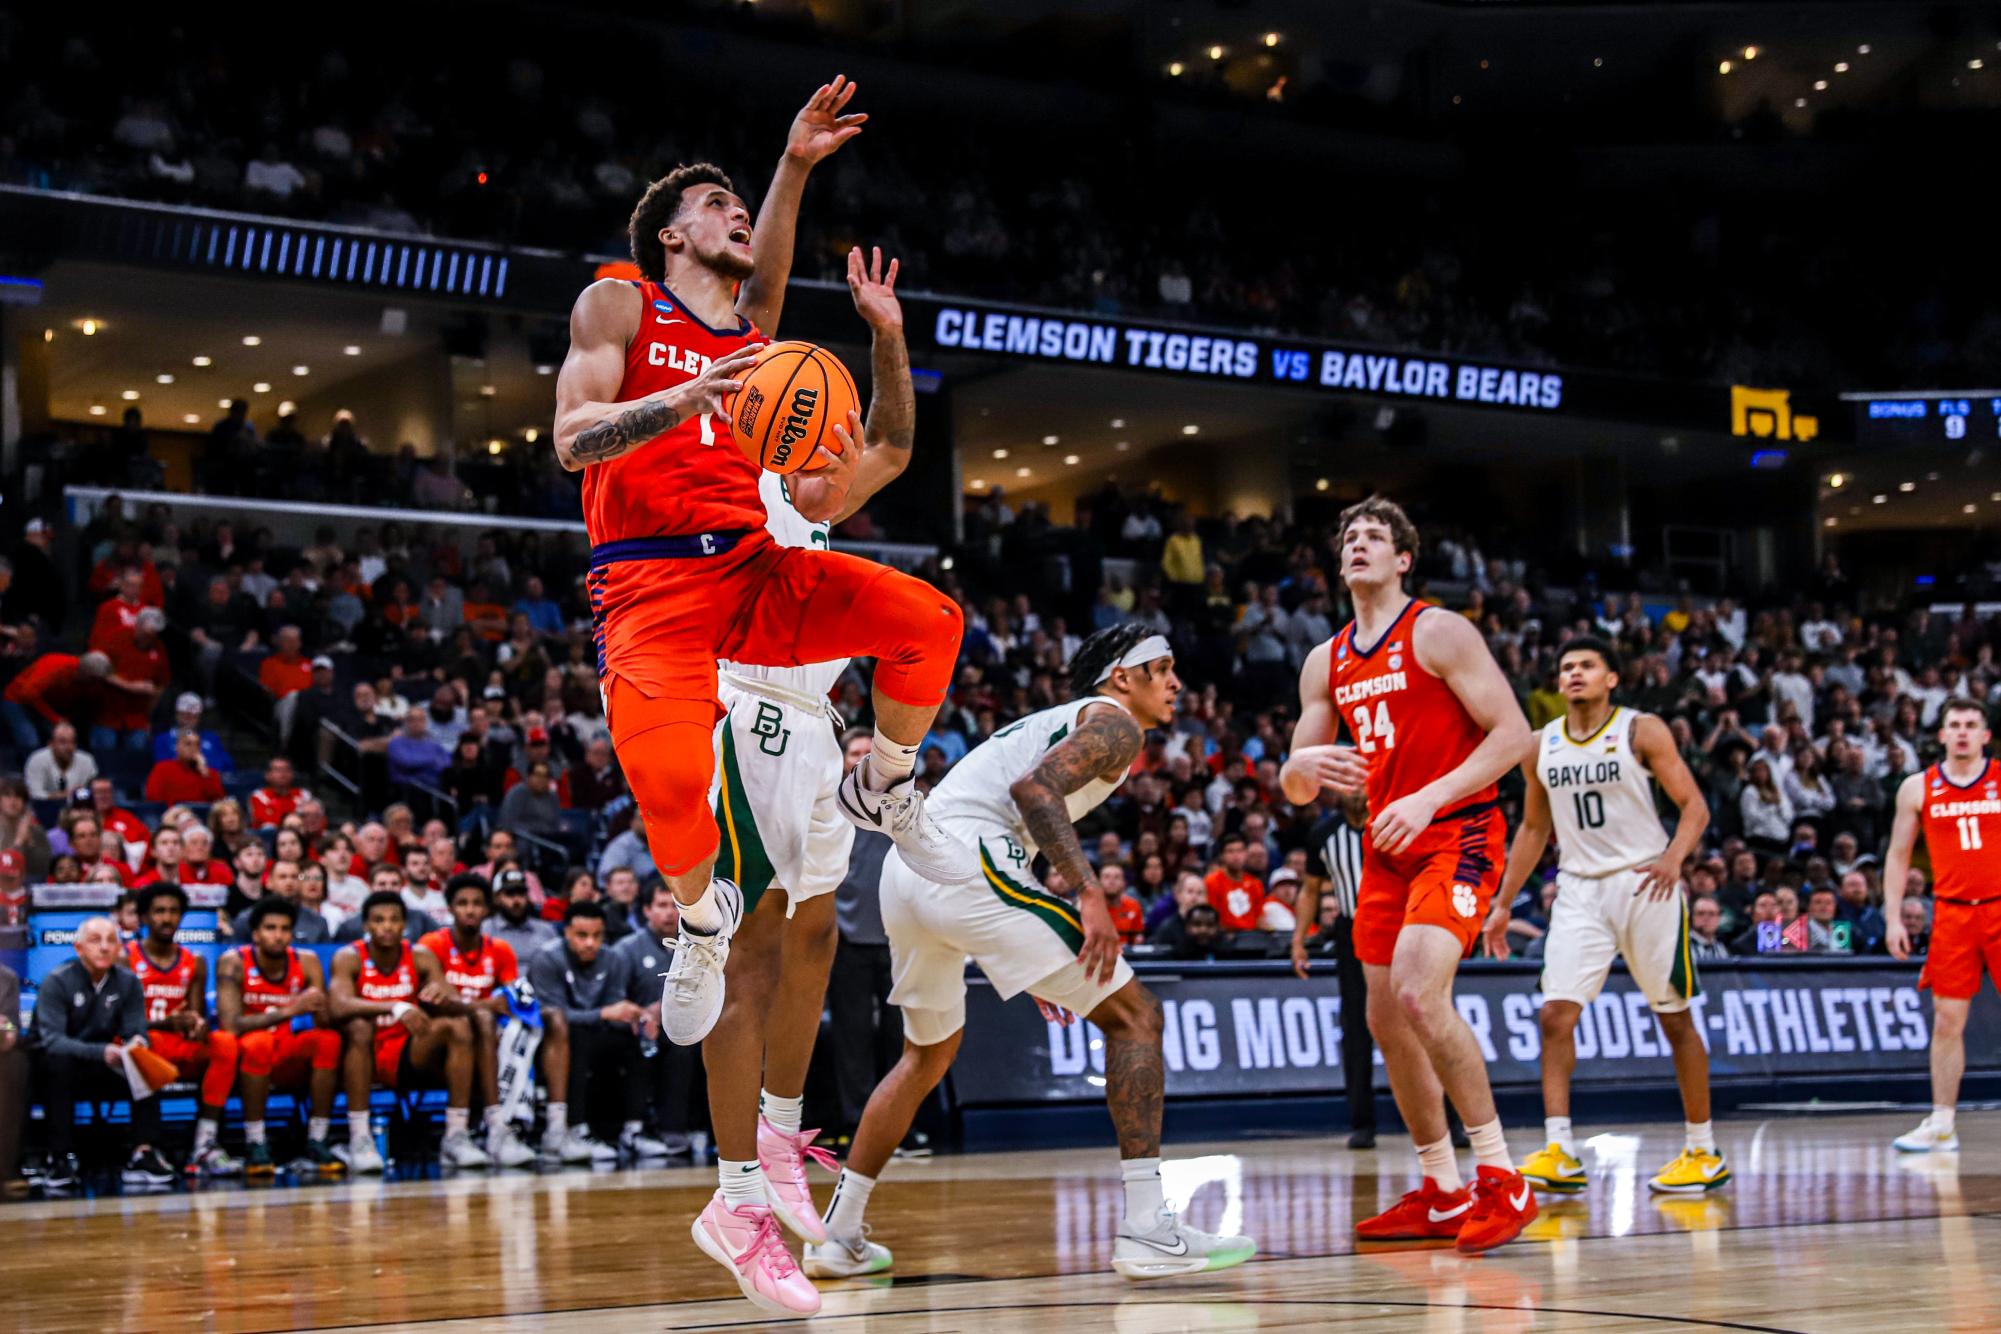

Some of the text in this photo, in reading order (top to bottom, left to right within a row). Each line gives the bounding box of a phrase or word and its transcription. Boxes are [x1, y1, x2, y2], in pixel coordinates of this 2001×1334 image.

[935, 308, 1562, 409] CLEMSON TIGERS VS BAYLOR BEARS
[770, 388, 819, 466] Wilson
[700, 533, 716, 555] C
[1335, 671, 1408, 705] CLEMSON
[1353, 700, 1396, 753] 24
[1547, 761, 1621, 788] BAYLOR
[1573, 789, 1606, 831] 10
[1956, 816, 1983, 850] 11
